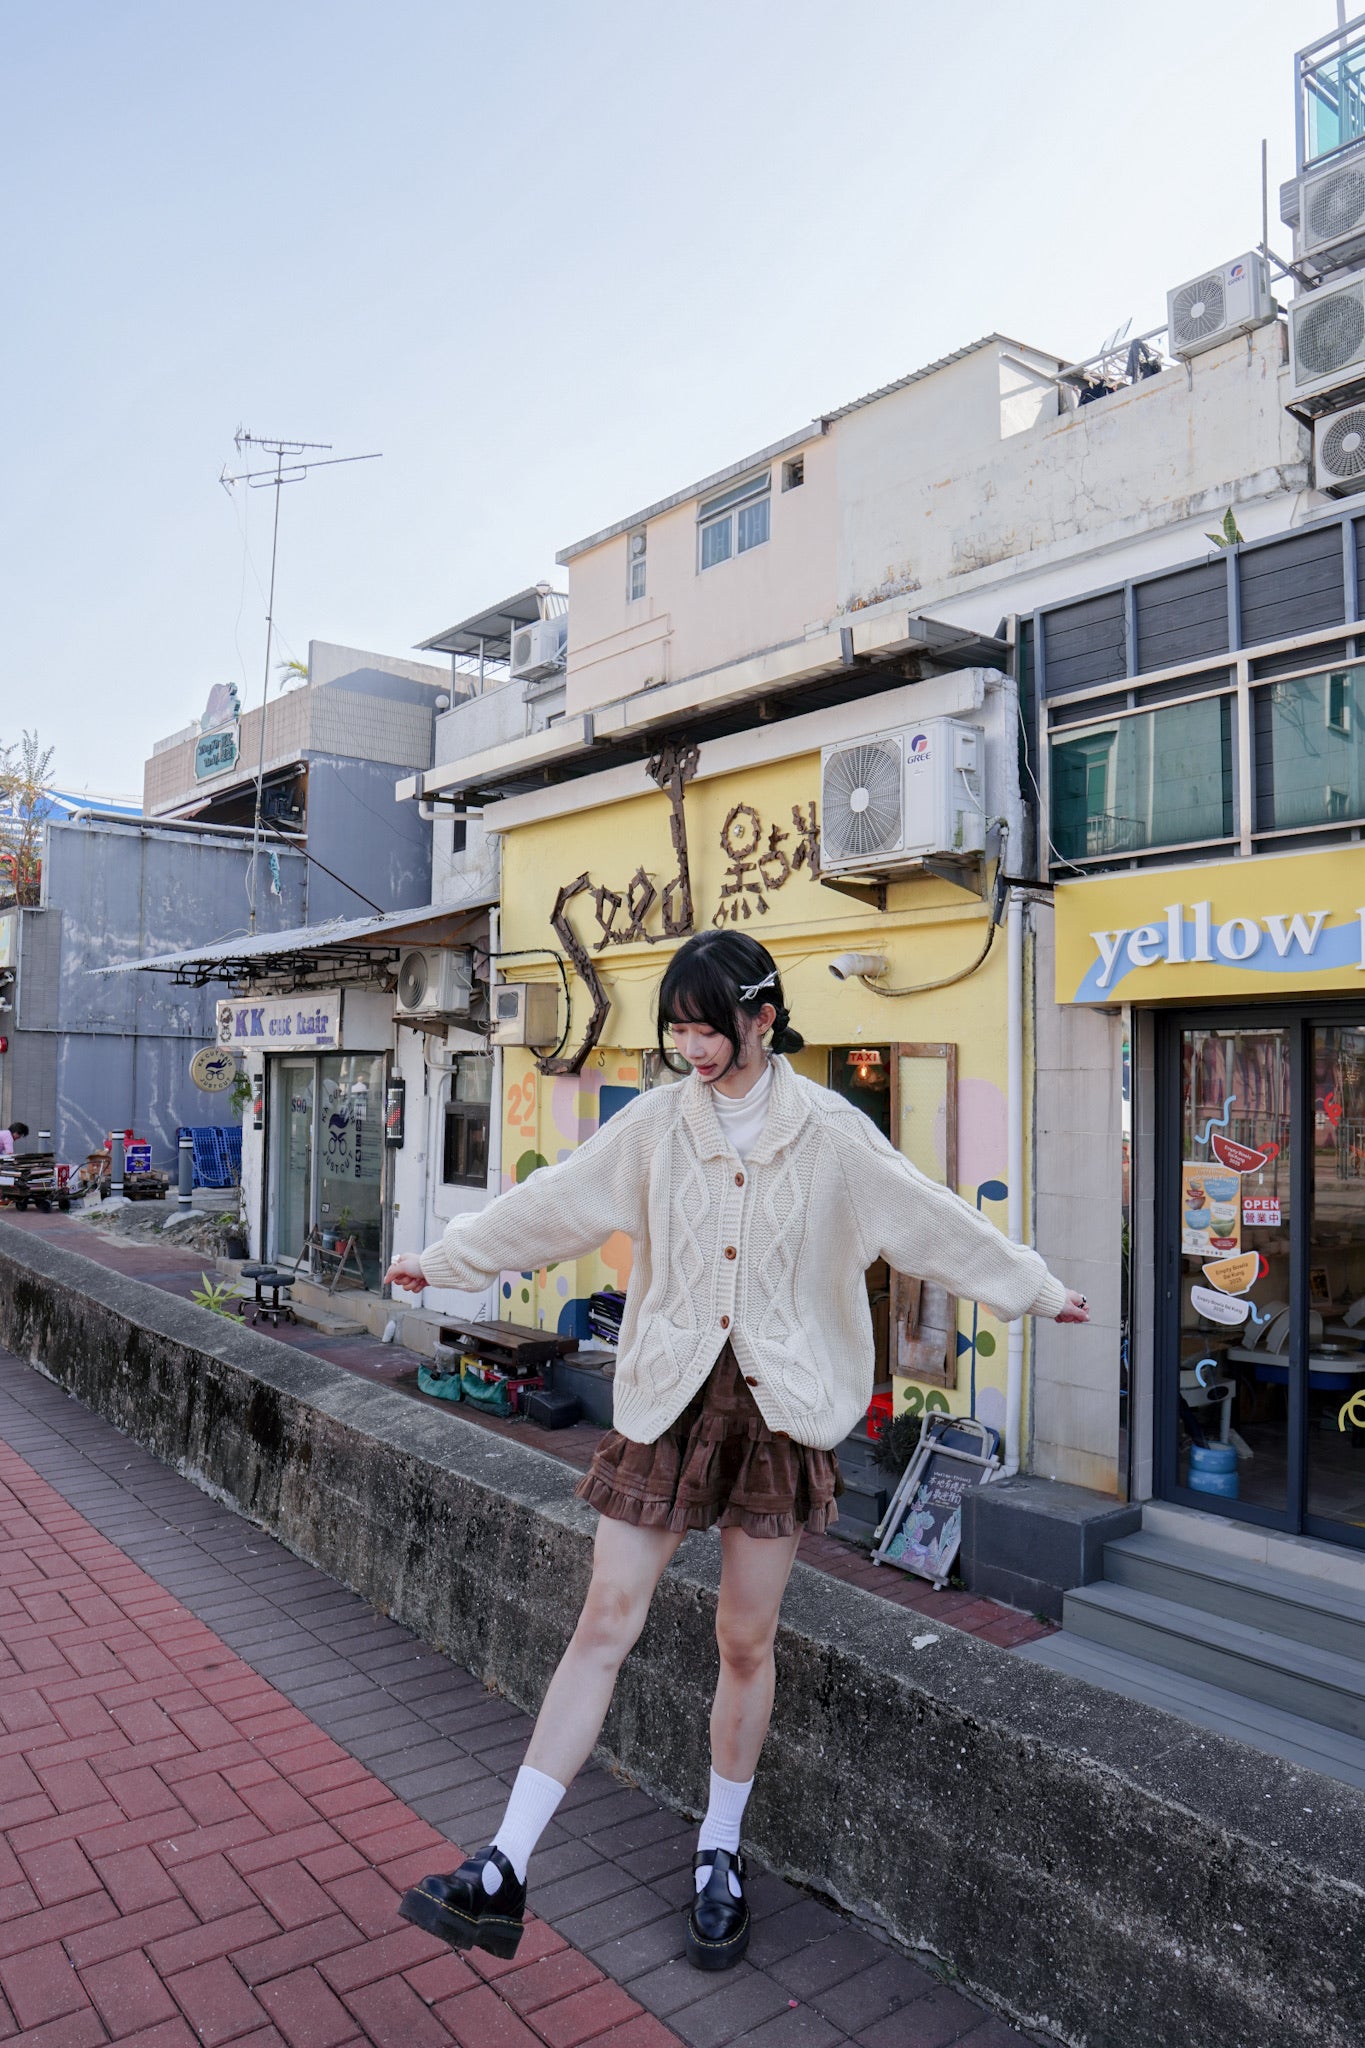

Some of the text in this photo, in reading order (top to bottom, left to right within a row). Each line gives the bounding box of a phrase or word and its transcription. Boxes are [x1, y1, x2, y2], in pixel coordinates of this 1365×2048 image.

[907, 752, 932, 765] GREE
[534, 739, 701, 1078] Seed
[1089, 900, 1333, 988] yellow
[234, 1008, 329, 1037] KK cut hair
[850, 1053, 878, 1061] TAXI
[507, 1071, 536, 1126] 29
[1243, 1199, 1280, 1210] OPEN
[1245, 1212, 1279, 1224] 營業中
[1216, 1266, 1232, 1275] Empty
